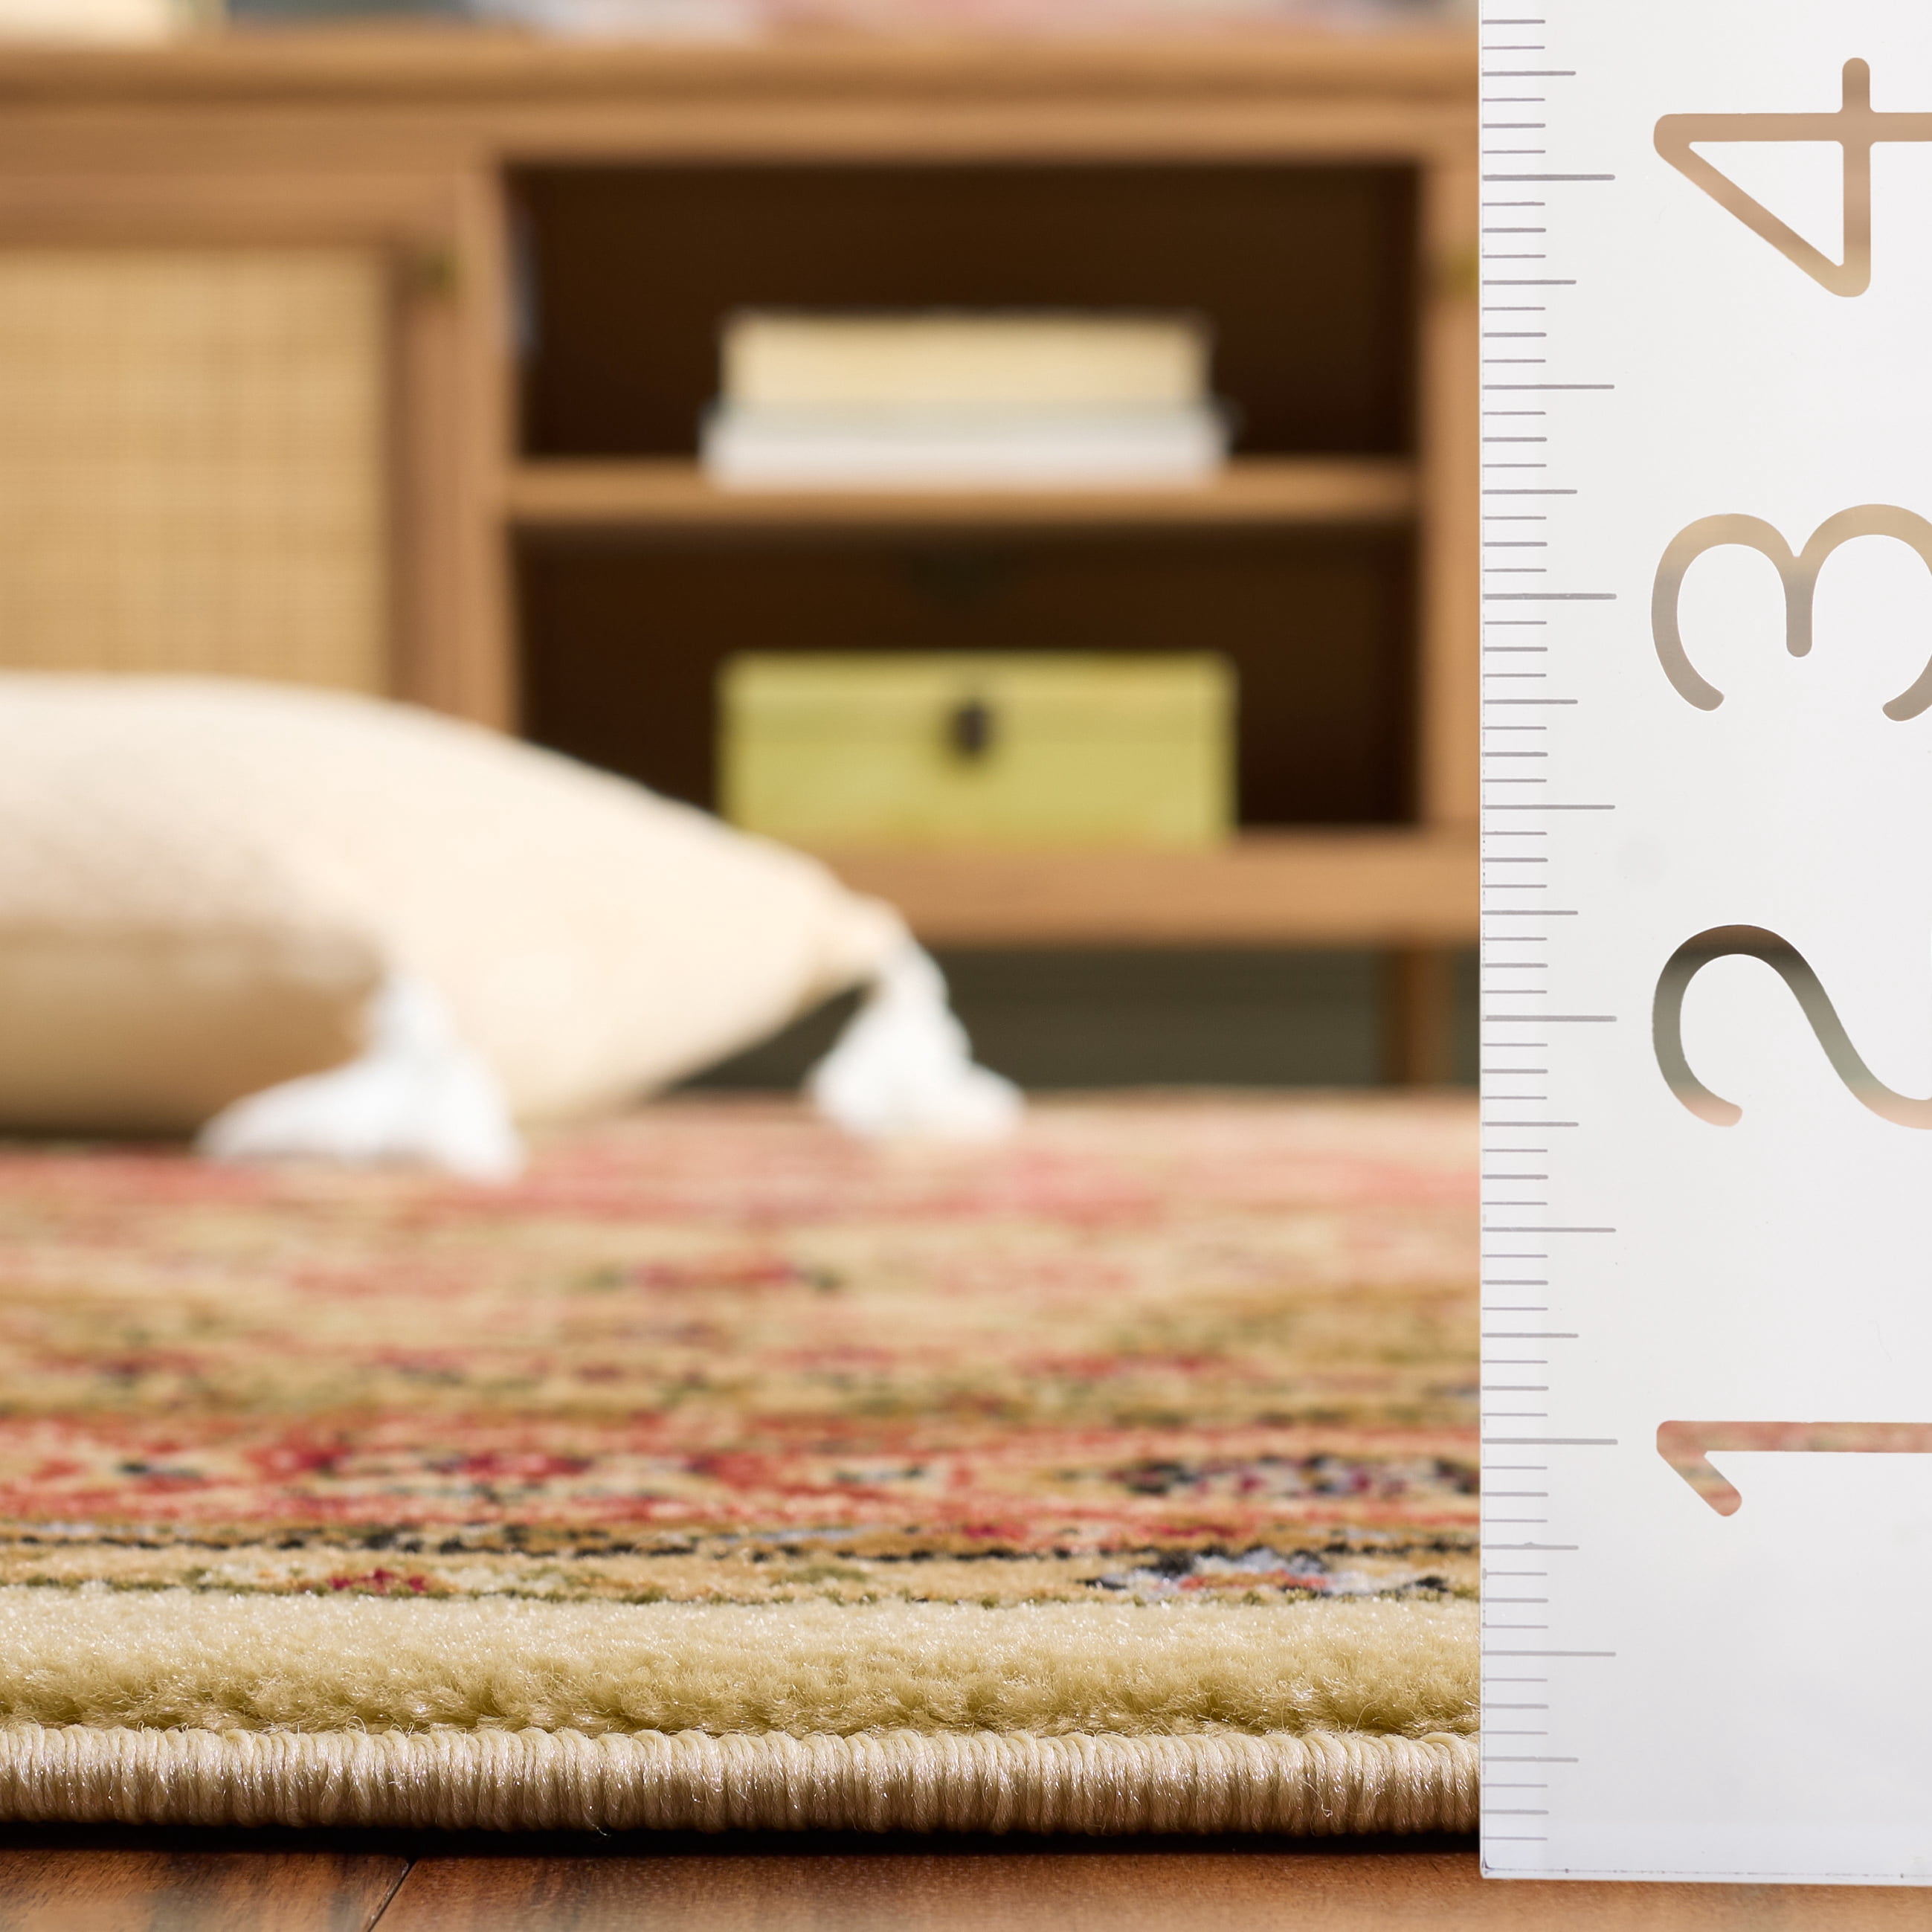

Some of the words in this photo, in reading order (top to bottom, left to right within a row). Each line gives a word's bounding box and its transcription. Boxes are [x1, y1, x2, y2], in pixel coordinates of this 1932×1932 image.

[1653, 57, 1932, 297] 4
[1652, 503, 1932, 721] 3
[1652, 924, 1932, 1130] 2
[1656, 1420, 1932, 1516] 1
